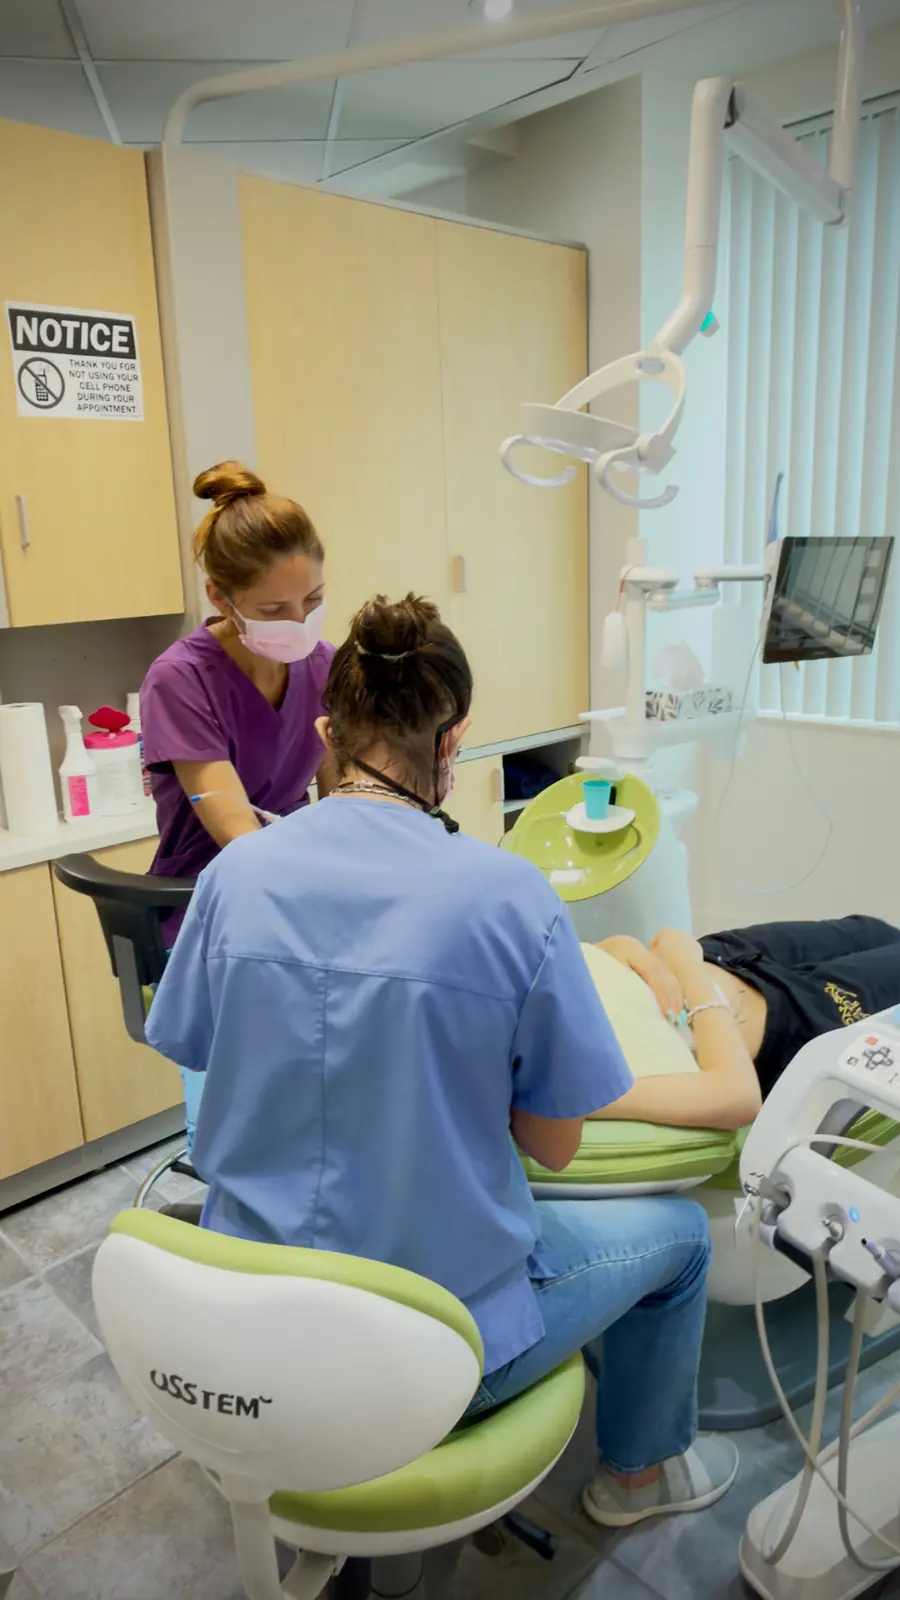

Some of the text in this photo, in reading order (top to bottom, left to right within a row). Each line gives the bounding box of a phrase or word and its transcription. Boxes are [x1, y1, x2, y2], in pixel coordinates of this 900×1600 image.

[16, 315, 130, 353] NOTICE
[68, 359, 136, 371] THANK YOU FOR
[69, 370, 139, 382] NOT USING YOUR
[79, 381, 131, 392] CELL PHONE
[76, 392, 135, 403] DURING YOUR
[76, 403, 137, 413] APPOINTMENT
